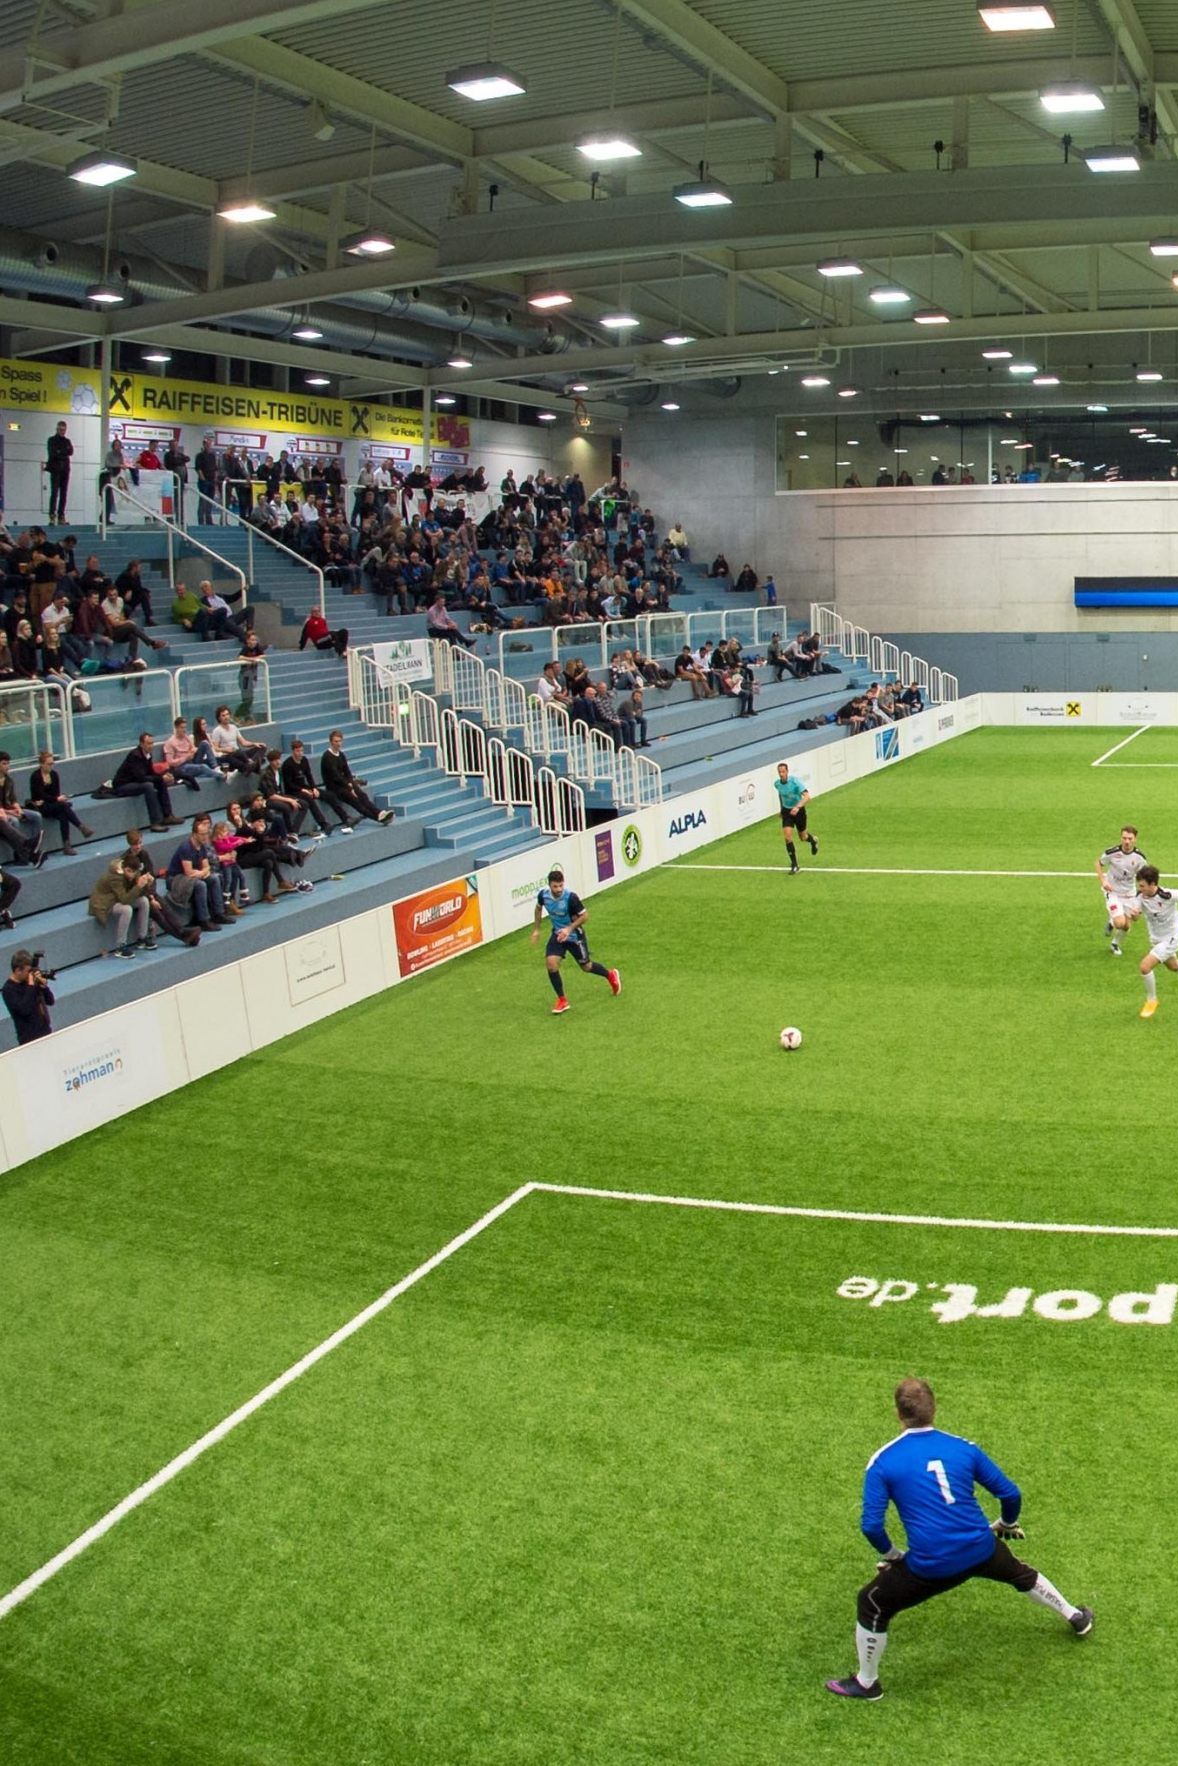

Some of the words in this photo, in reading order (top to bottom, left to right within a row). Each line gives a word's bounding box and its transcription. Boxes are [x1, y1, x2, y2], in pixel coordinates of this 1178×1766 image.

[1, 364, 42, 382] Spass
[143, 387, 343, 428] RAIFFEISEN-TRIBÜNE
[669, 809, 707, 838] ALPLA
[926, 1459, 955, 1505] 1
